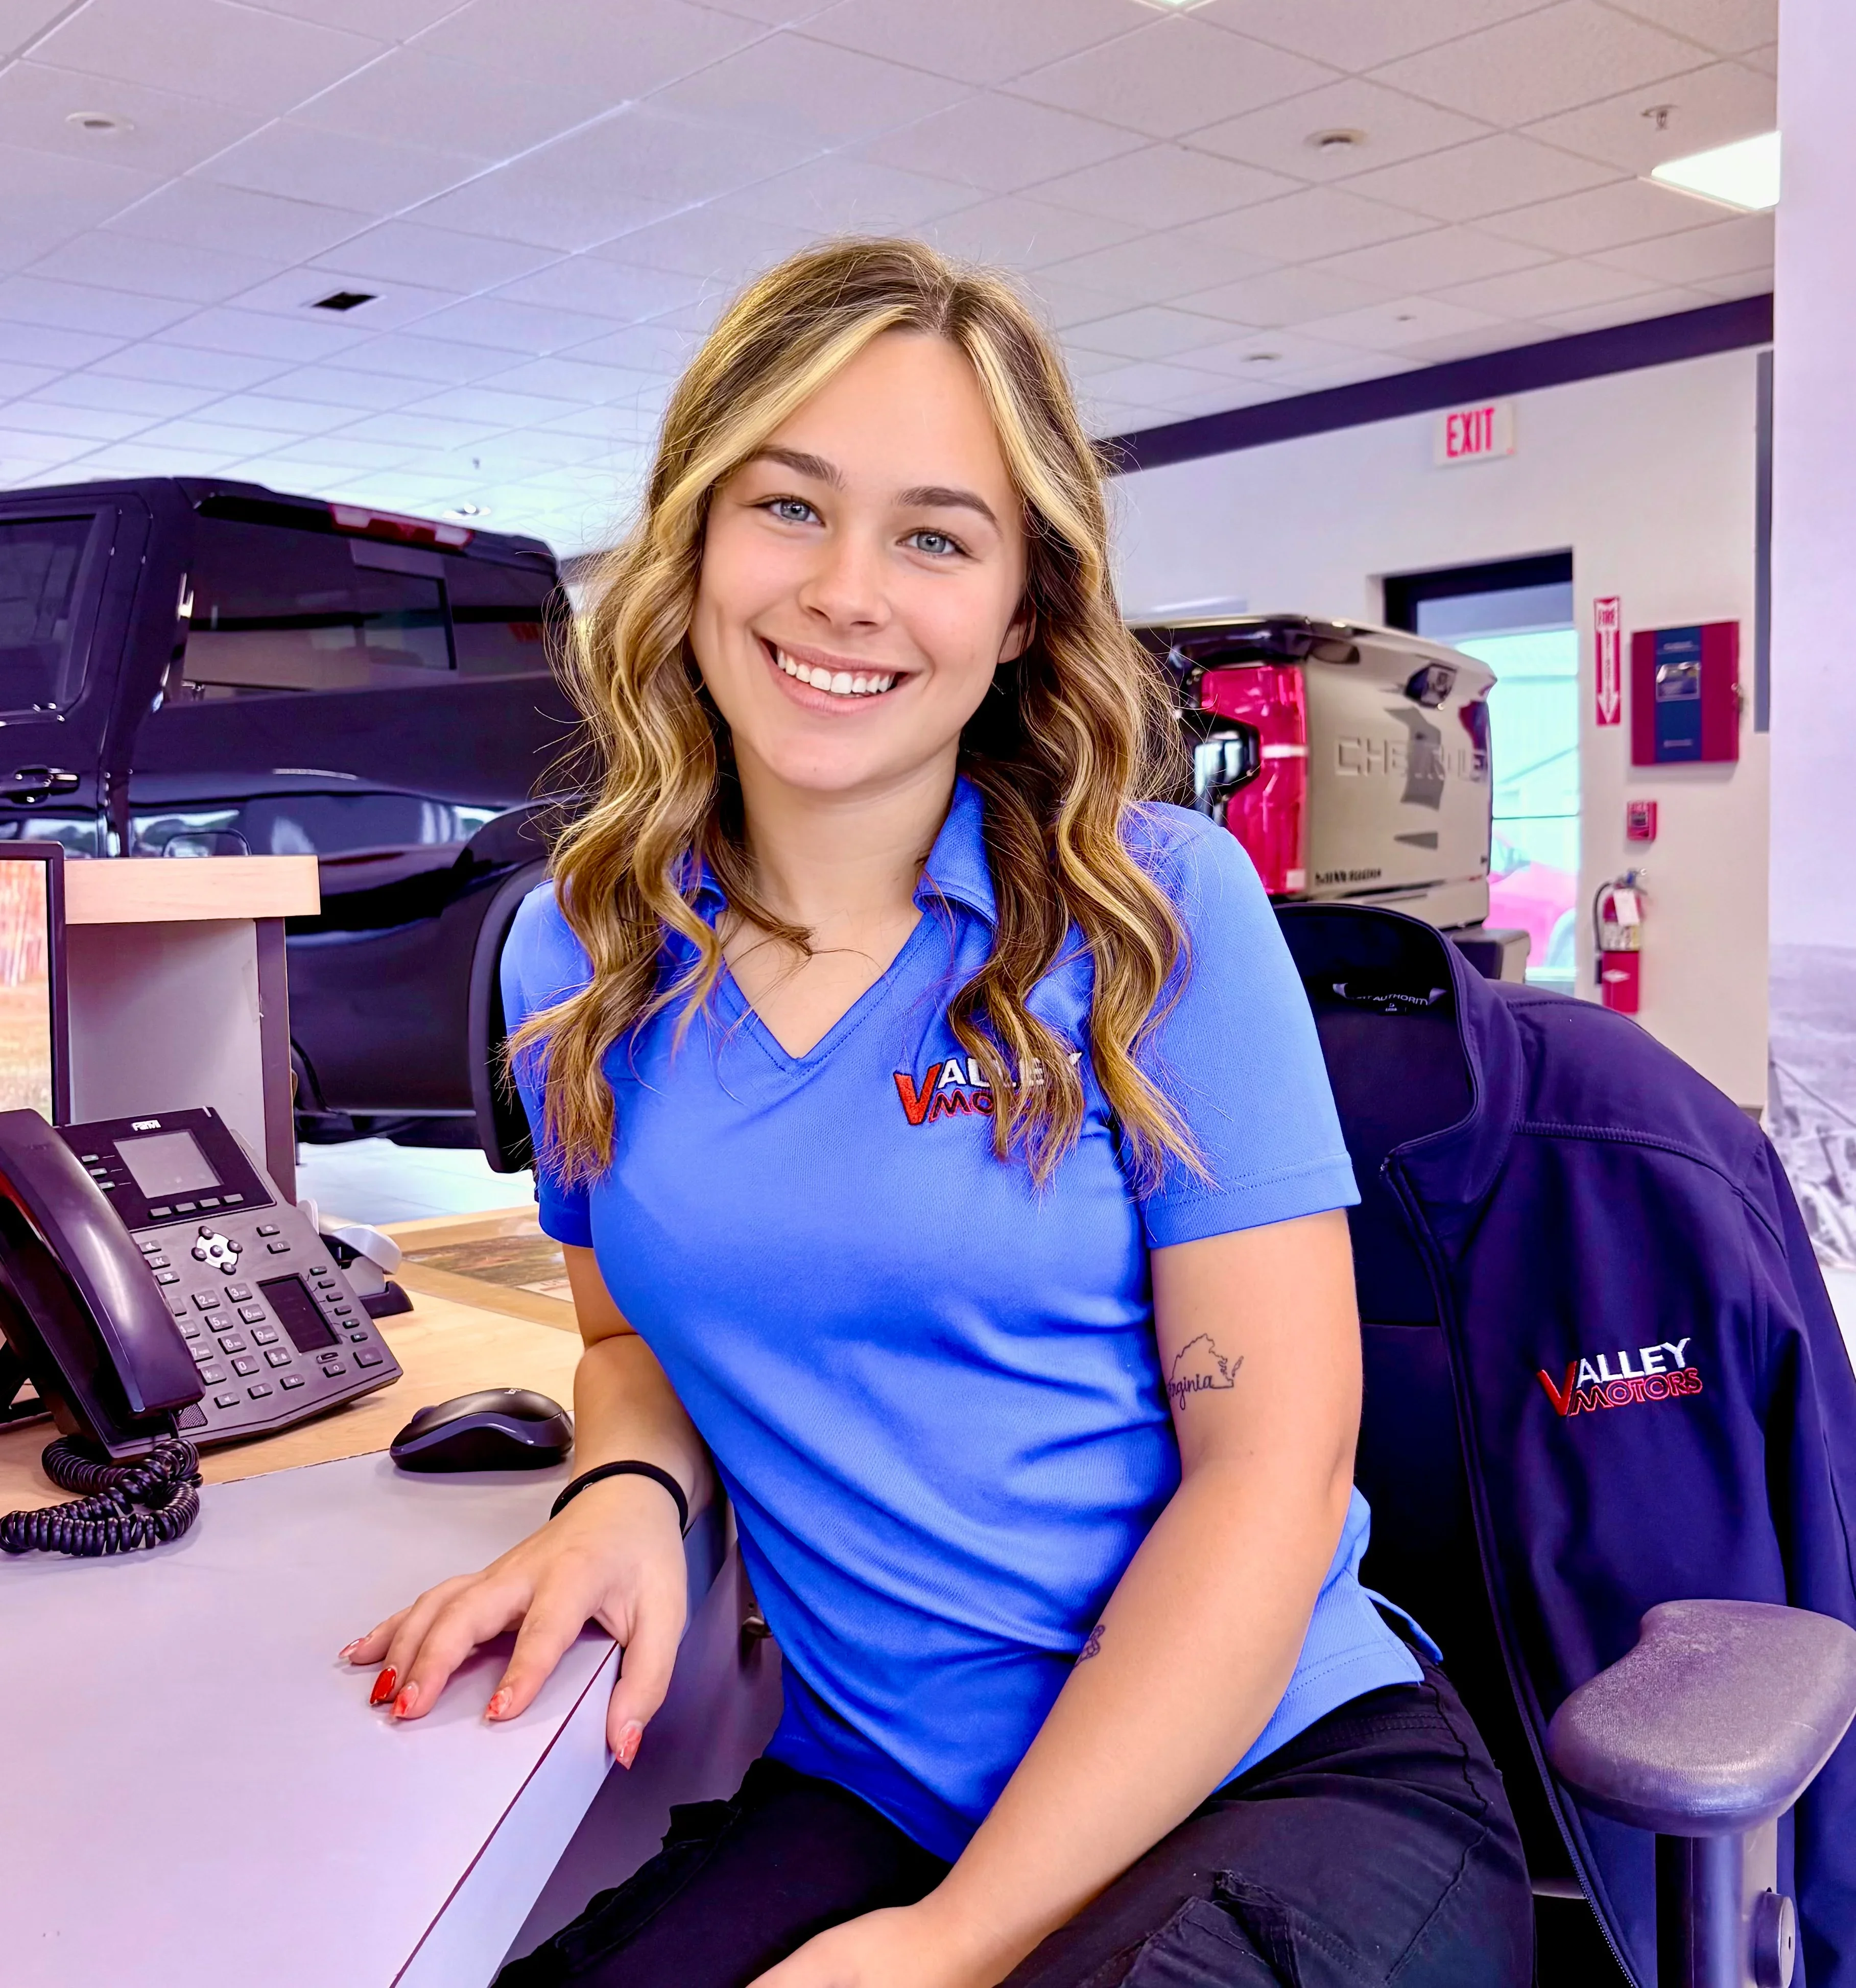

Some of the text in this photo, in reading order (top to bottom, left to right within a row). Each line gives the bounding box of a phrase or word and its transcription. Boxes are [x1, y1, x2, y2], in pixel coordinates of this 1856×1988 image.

[1446, 408, 1494, 458] EXIT
[231, 1288, 239, 1297] 3
[199, 1296, 208, 1304] 2
[245, 1309, 252, 1318] 6
[212, 1317, 220, 1326] 5
[257, 1331, 264, 1339] 9
[225, 1339, 233, 1348] 8
[1536, 1337, 1692, 1417] VALLEY
[1568, 1367, 1703, 1417] MOTORS
